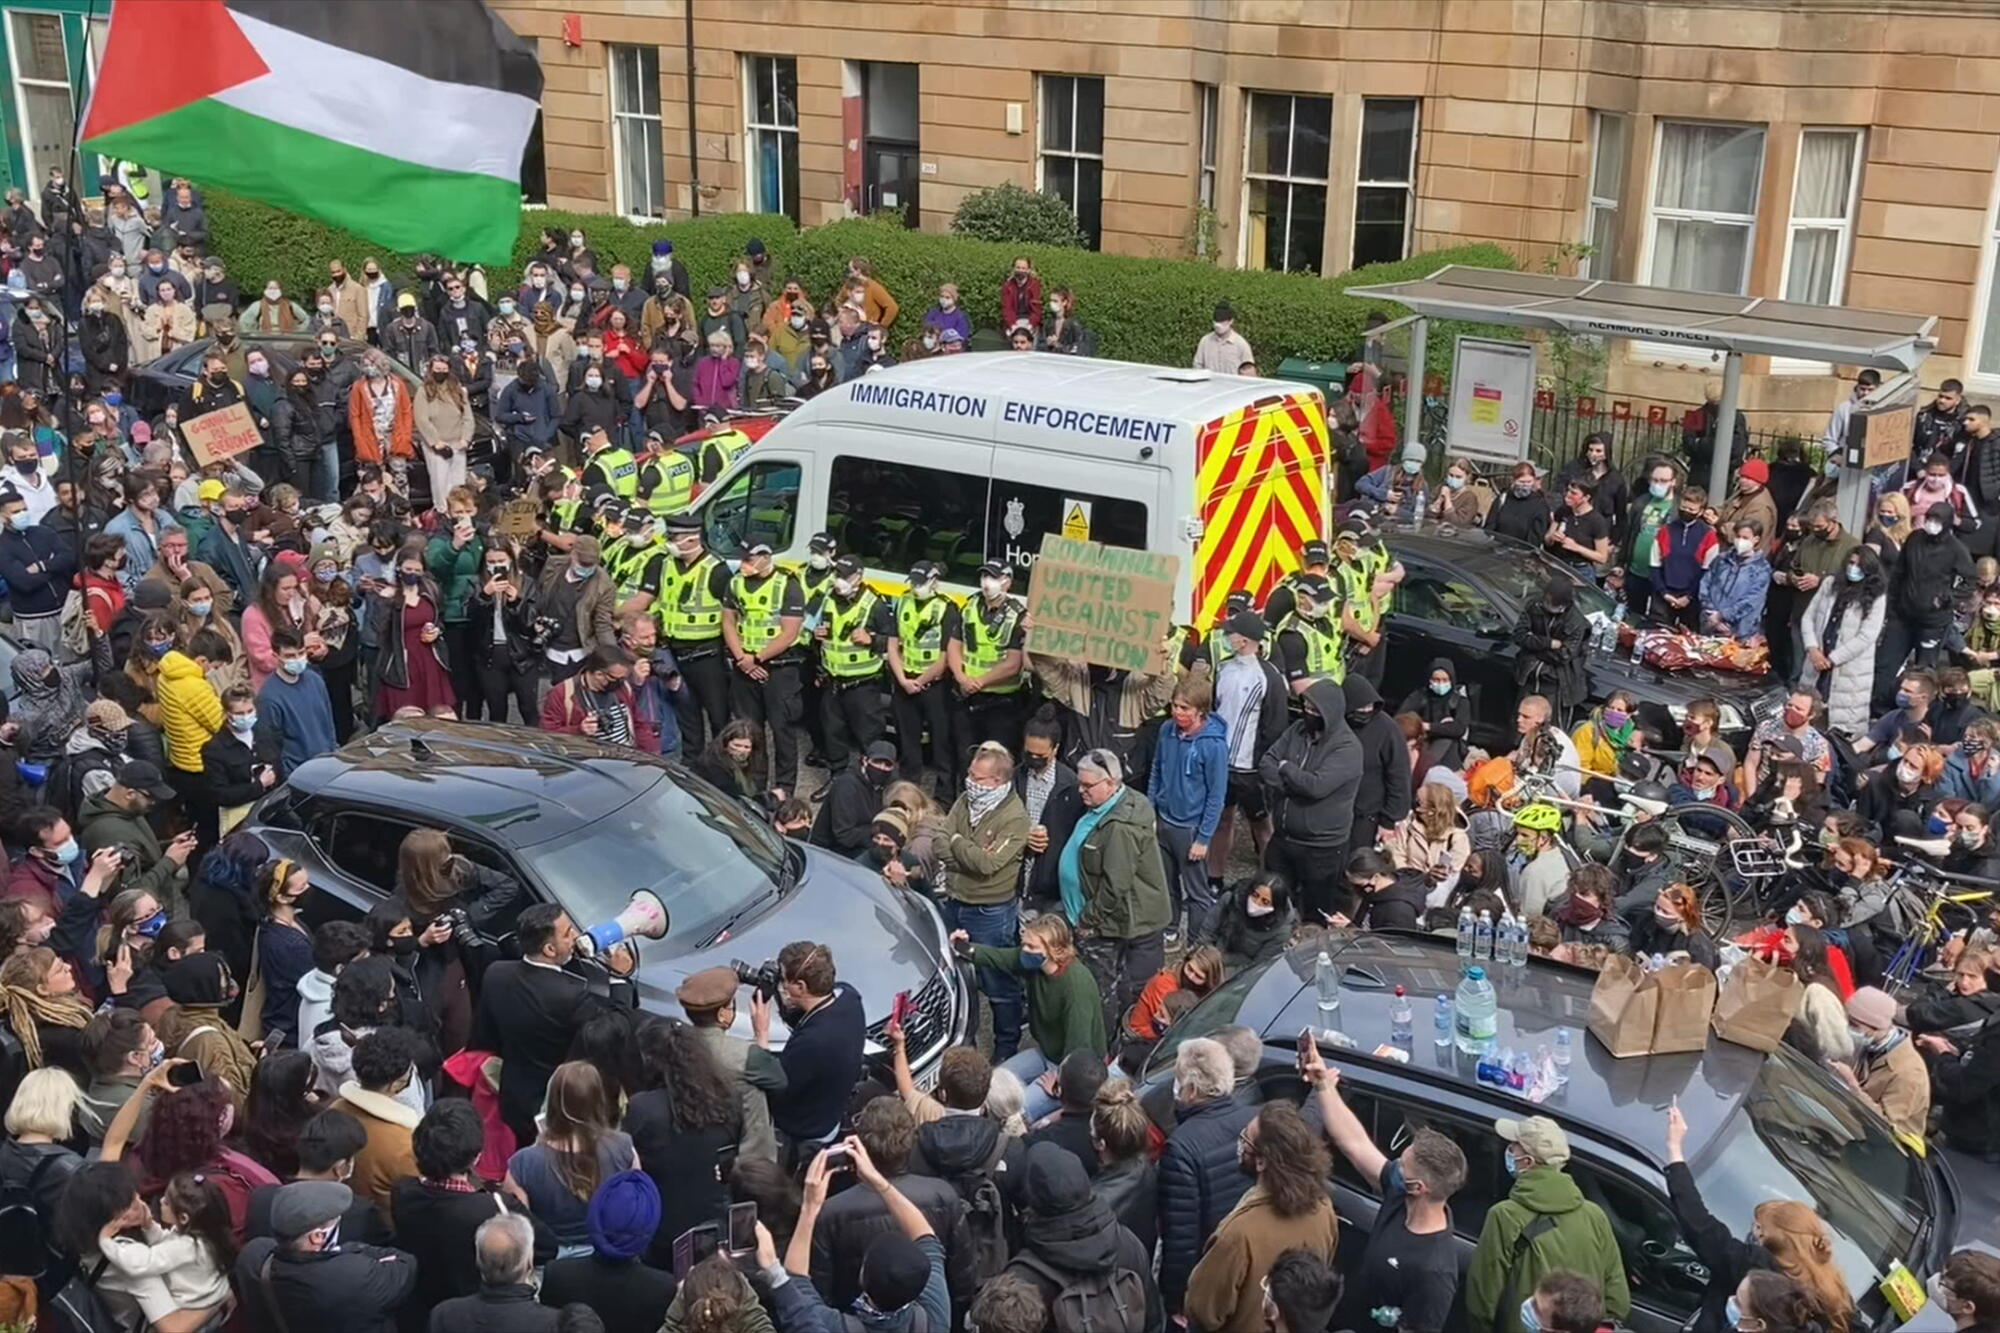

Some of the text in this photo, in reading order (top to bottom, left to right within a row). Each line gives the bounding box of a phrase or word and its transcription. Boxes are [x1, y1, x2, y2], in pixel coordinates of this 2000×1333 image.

[850, 382, 1177, 445] IMMIGRATION ENFORCEMENT
[1042, 566, 1133, 603] UNITED
[1035, 594, 1163, 641] AGAINST
[1030, 625, 1149, 671] EVICTION
